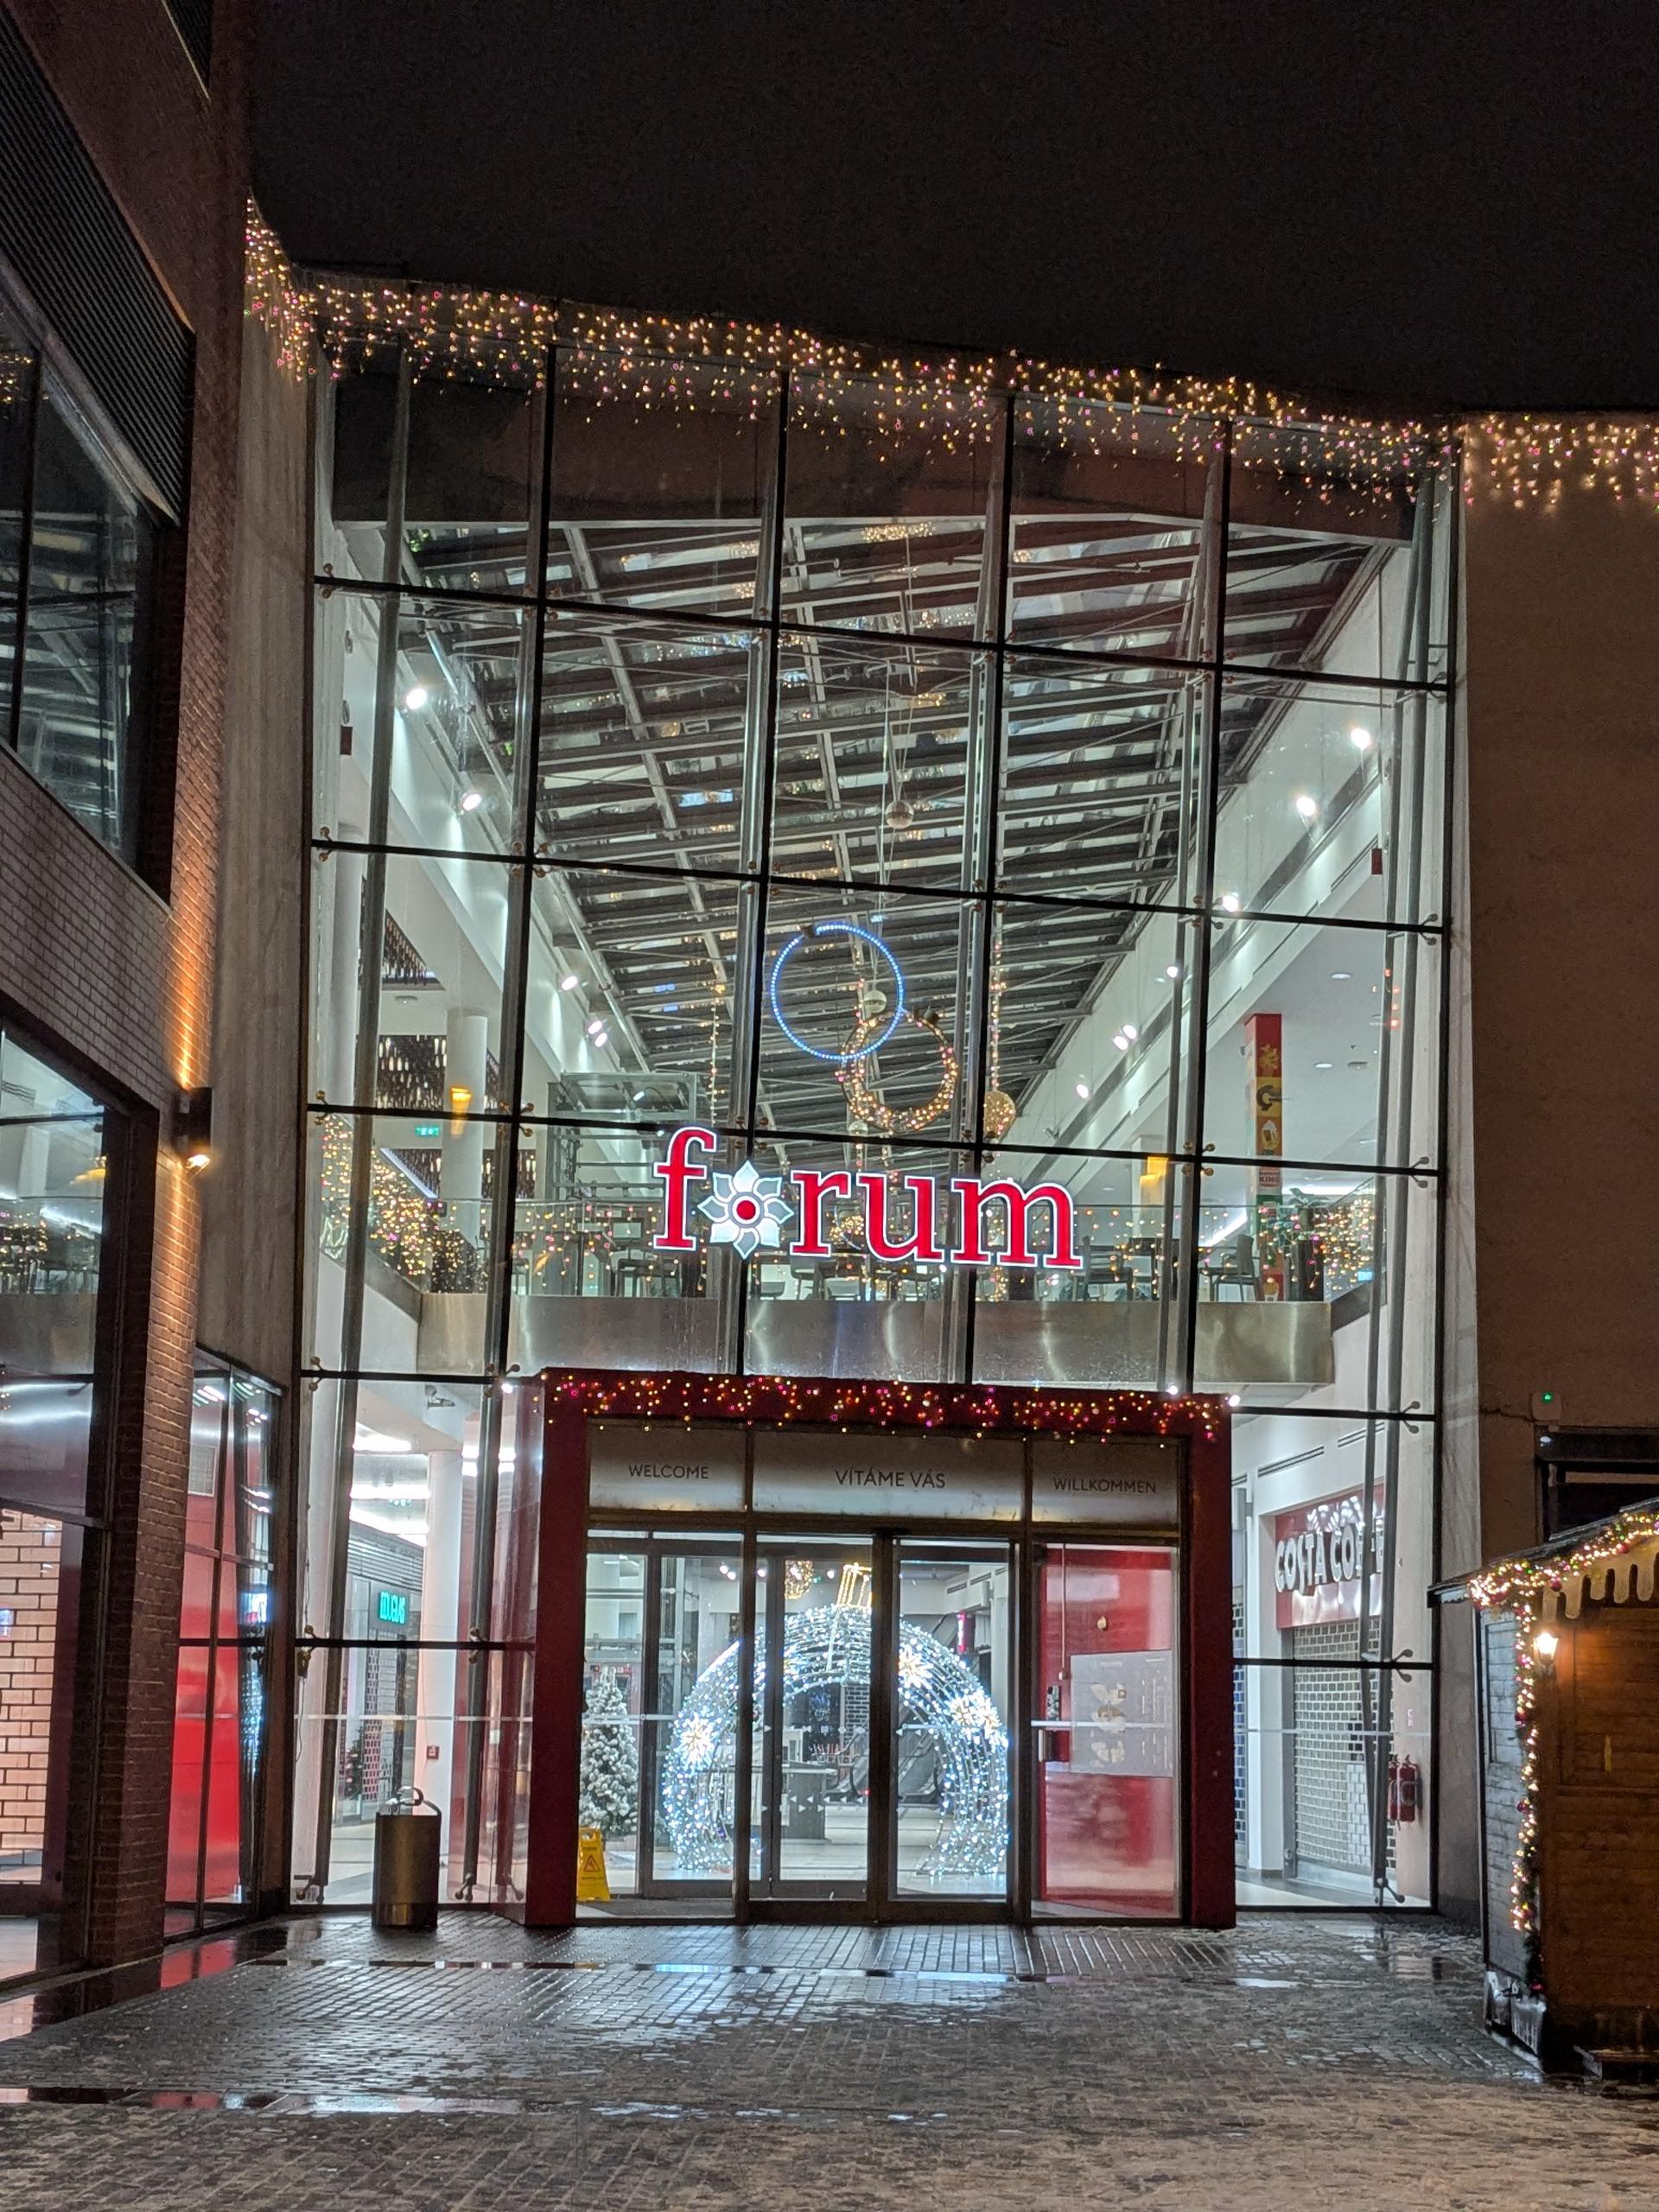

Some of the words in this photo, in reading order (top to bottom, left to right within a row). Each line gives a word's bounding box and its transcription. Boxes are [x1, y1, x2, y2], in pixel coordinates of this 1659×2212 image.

[653, 1126, 1084, 1271] forum
[628, 1464, 709, 1480] WELCOME
[909, 1469, 946, 1489] VÁS
[1053, 1478, 1157, 1494] WILLKOMMEN
[1274, 1532, 1328, 1598] COSTA
